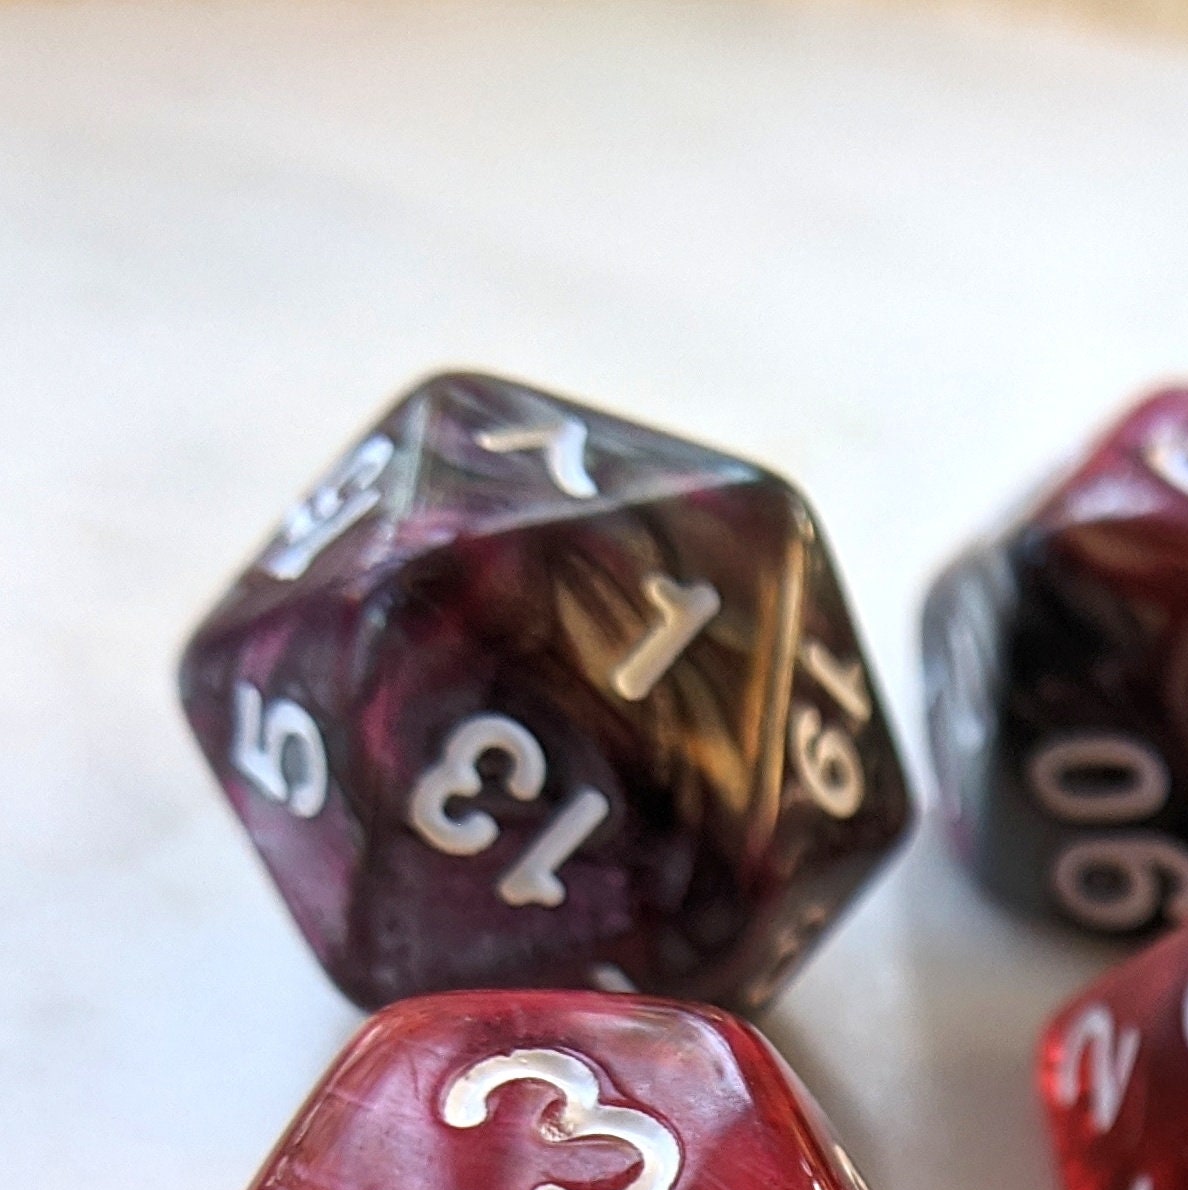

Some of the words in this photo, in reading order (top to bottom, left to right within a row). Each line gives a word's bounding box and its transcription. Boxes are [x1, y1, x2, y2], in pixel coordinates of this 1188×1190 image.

[475, 417, 599, 499] 7
[609, 572, 721, 701] 1
[231, 682, 329, 819] 5
[409, 713, 609, 908] 13
[1058, 1003, 1140, 1134] 2
